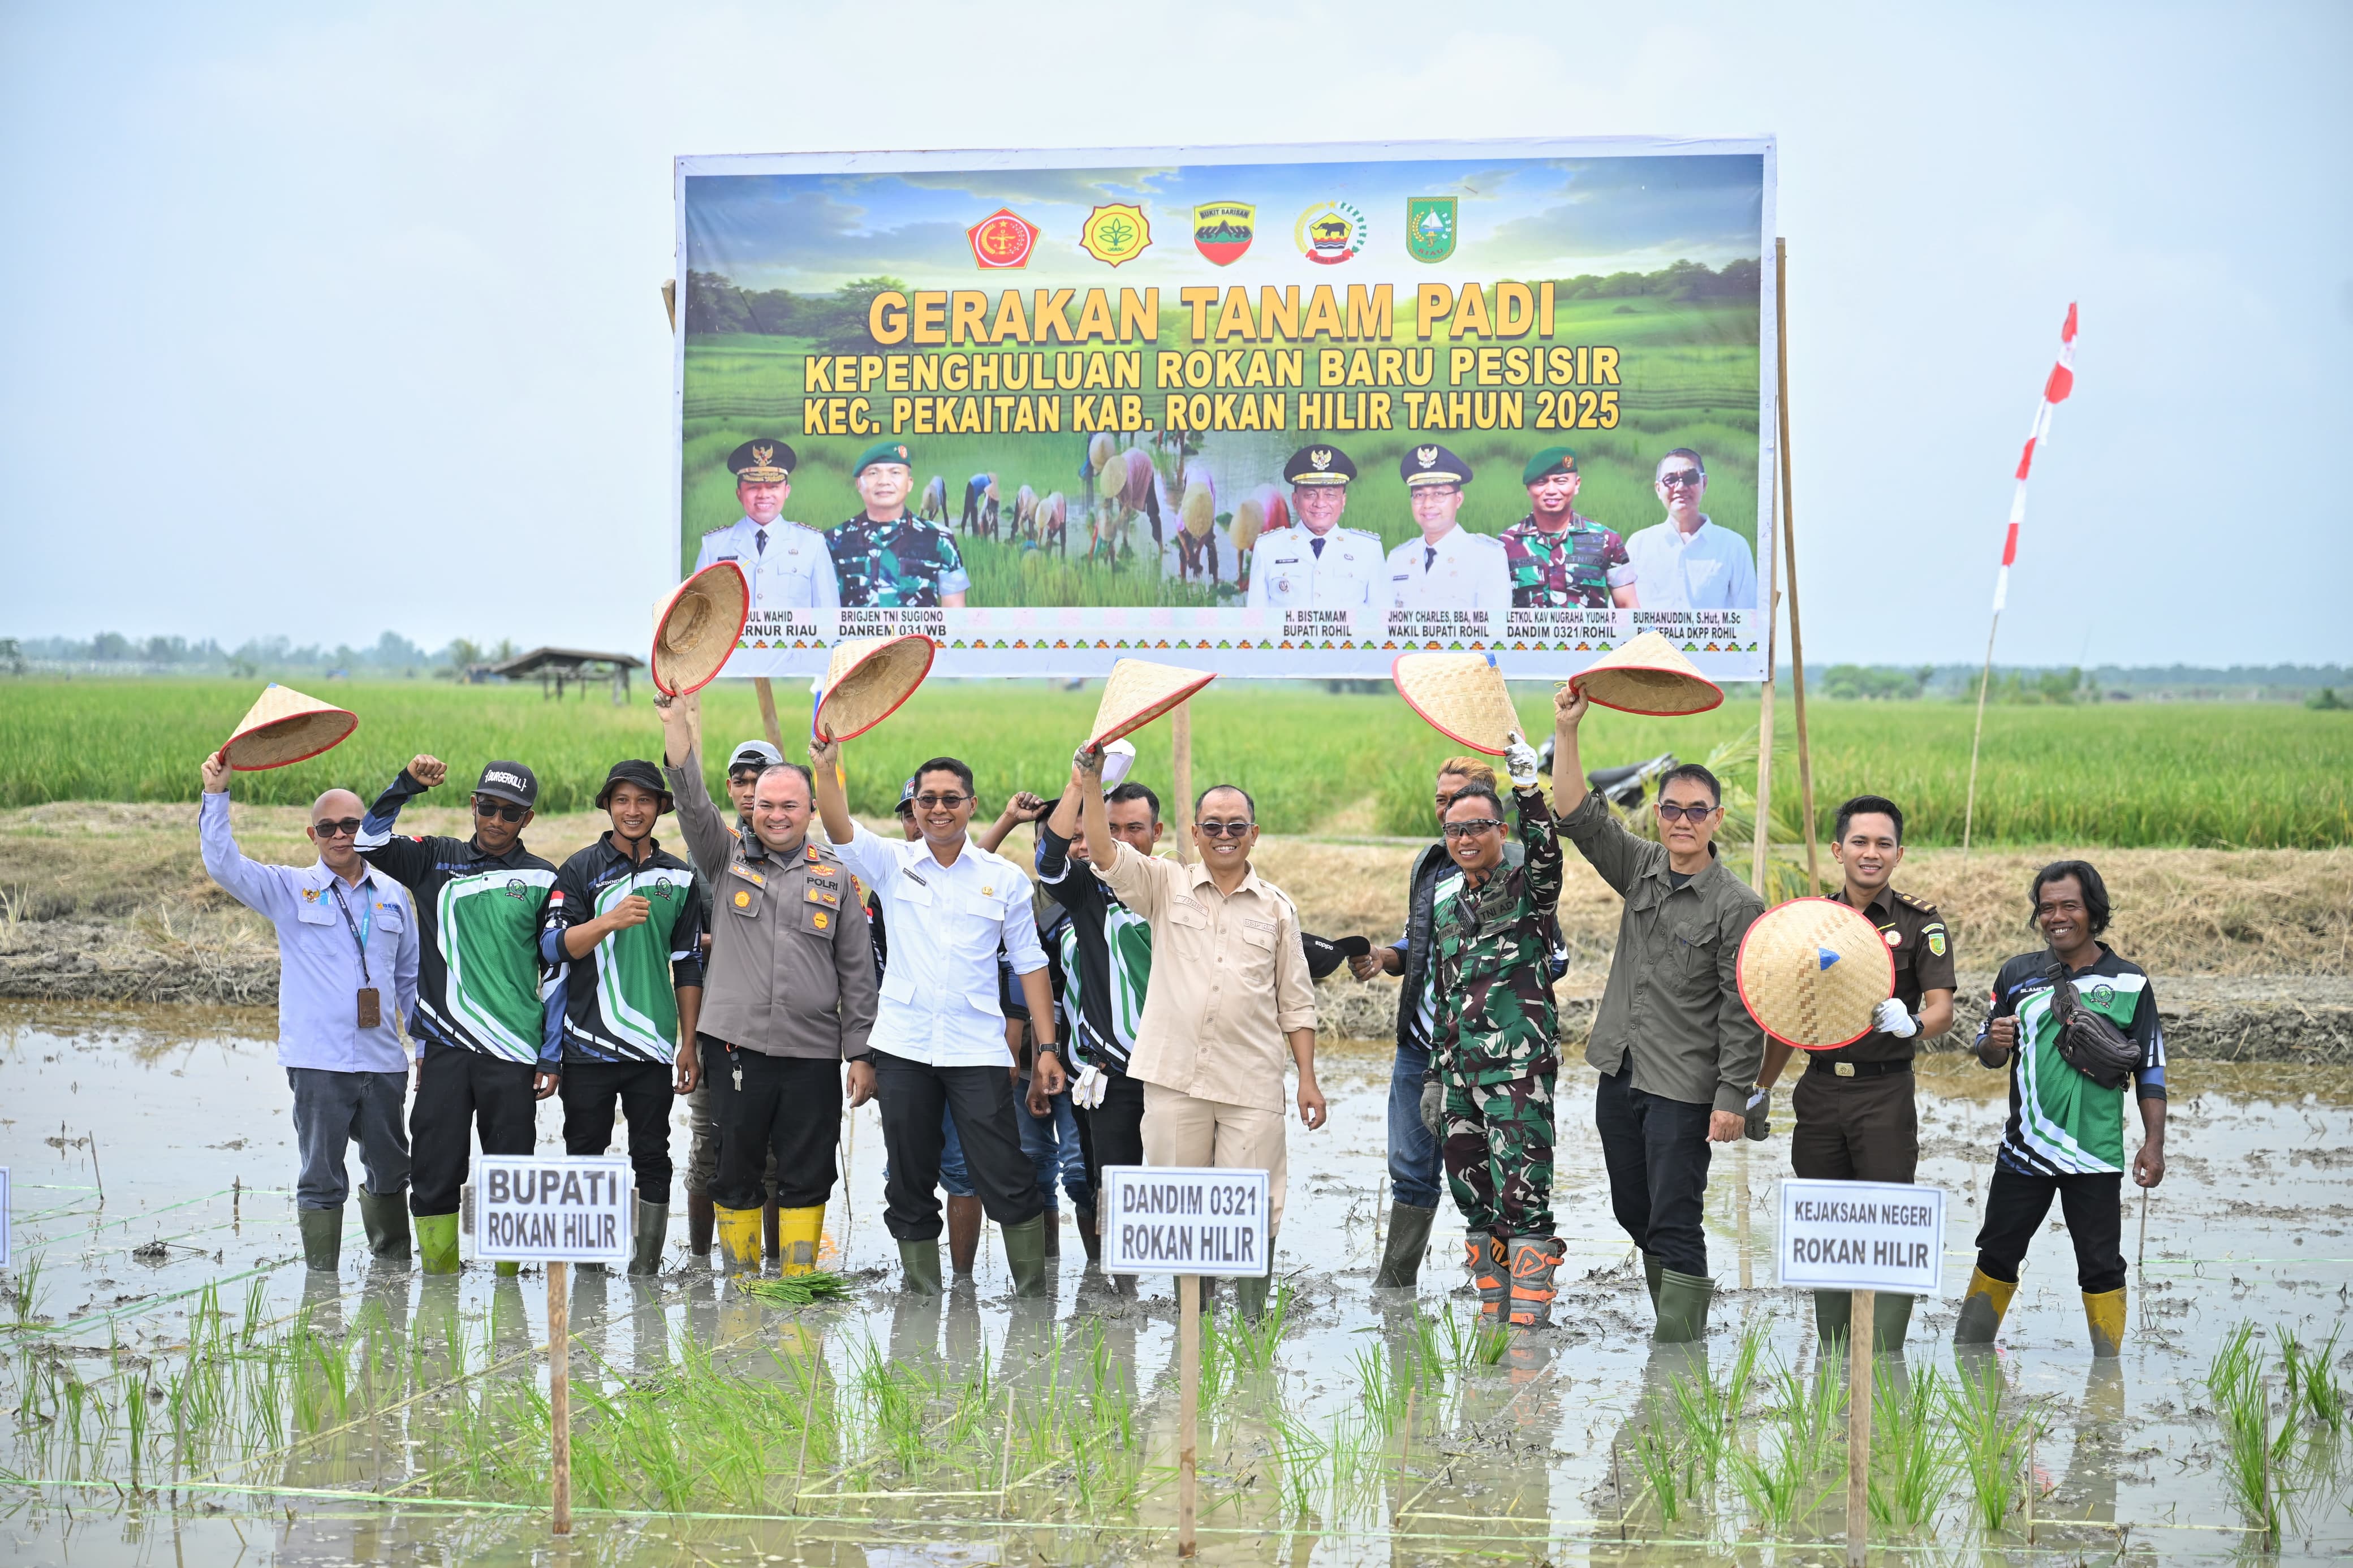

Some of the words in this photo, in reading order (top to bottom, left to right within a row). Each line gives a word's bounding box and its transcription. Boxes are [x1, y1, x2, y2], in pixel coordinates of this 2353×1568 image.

[1200, 209, 1219, 219] BUKIT
[1222, 209, 1249, 219] BARISAN
[869, 287, 1160, 346] GERAKAN
[1180, 284, 1394, 342] TANAM
[1416, 281, 1555, 338] PADI
[804, 349, 1141, 394] KEPENGHULUAN
[1156, 348, 1304, 390] ROKAN
[1318, 347, 1434, 387] BARU
[1450, 345, 1621, 386] PESISIR
[803, 397, 881, 436] KEC.
[892, 395, 1061, 435] PEKAITAN
[1072, 394, 1153, 433] KAB.
[1165, 392, 1286, 431] ROKAN
[1297, 391, 1391, 430] HILIR
[1403, 390, 1524, 430] TAHUN
[1535, 389, 1620, 429] 2025
[764, 611, 793, 622] WAHID
[841, 611, 880, 621] BRIGJEN
[883, 611, 898, 621] TNI
[901, 611, 943, 621] SUGIONO
[1286, 611, 1295, 622] H.
[1298, 611, 1347, 622] BISTAMAM
[1388, 611, 1413, 623] JHONY
[1416, 611, 1452, 625] CHARLES,
[1454, 611, 1471, 625] BBA,
[1473, 611, 1489, 623] MBA
[1506, 611, 1532, 623] LETKOL
[1535, 611, 1549, 623] KAV
[1550, 611, 1583, 623] NUGRAHA
[1586, 612, 1609, 623] YUDHA
[1611, 612, 1617, 623] P.
[1634, 612, 1694, 626] BURHANUDDIN,
[1696, 612, 1720, 626] S.Hut,
[1722, 612, 1741, 624] M.Sc
[786, 625, 817, 636] RIAU
[839, 624, 895, 636] DANREM
[899, 624, 947, 636] 031/WB
[1283, 625, 1318, 637] BUPATI
[1322, 625, 1352, 637] ROHIL
[1388, 625, 1419, 637] WAKIL
[1423, 625, 1456, 637] BUPATI
[1460, 625, 1489, 637] ROHIL
[1507, 626, 1550, 638] DANDIM
[1554, 626, 1617, 638] 0321/ROHIL
[1687, 627, 1709, 639] DKPP
[1712, 627, 1737, 639] ROHIL
[736, 855, 766, 876] B.KARDINAL
[807, 876, 838, 891] POLRI
[1480, 907, 1497, 920] TNI
[1497, 901, 1514, 914] AD
[1315, 940, 1334, 951] adidas
[489, 1169, 617, 1206] BUPATI
[1123, 1183, 1203, 1215] DANDIM
[1210, 1185, 1256, 1216] 0321
[1795, 1200, 1877, 1224] KEJAKSAAN
[1881, 1204, 1932, 1227] NEGERI
[488, 1212, 555, 1247] ROKAN
[564, 1213, 617, 1249] HILIR
[1122, 1224, 1193, 1261] ROKAN
[1201, 1225, 1255, 1262] HILIR
[1793, 1237, 1866, 1265] ROKAN
[1873, 1239, 1929, 1269] HILIR
